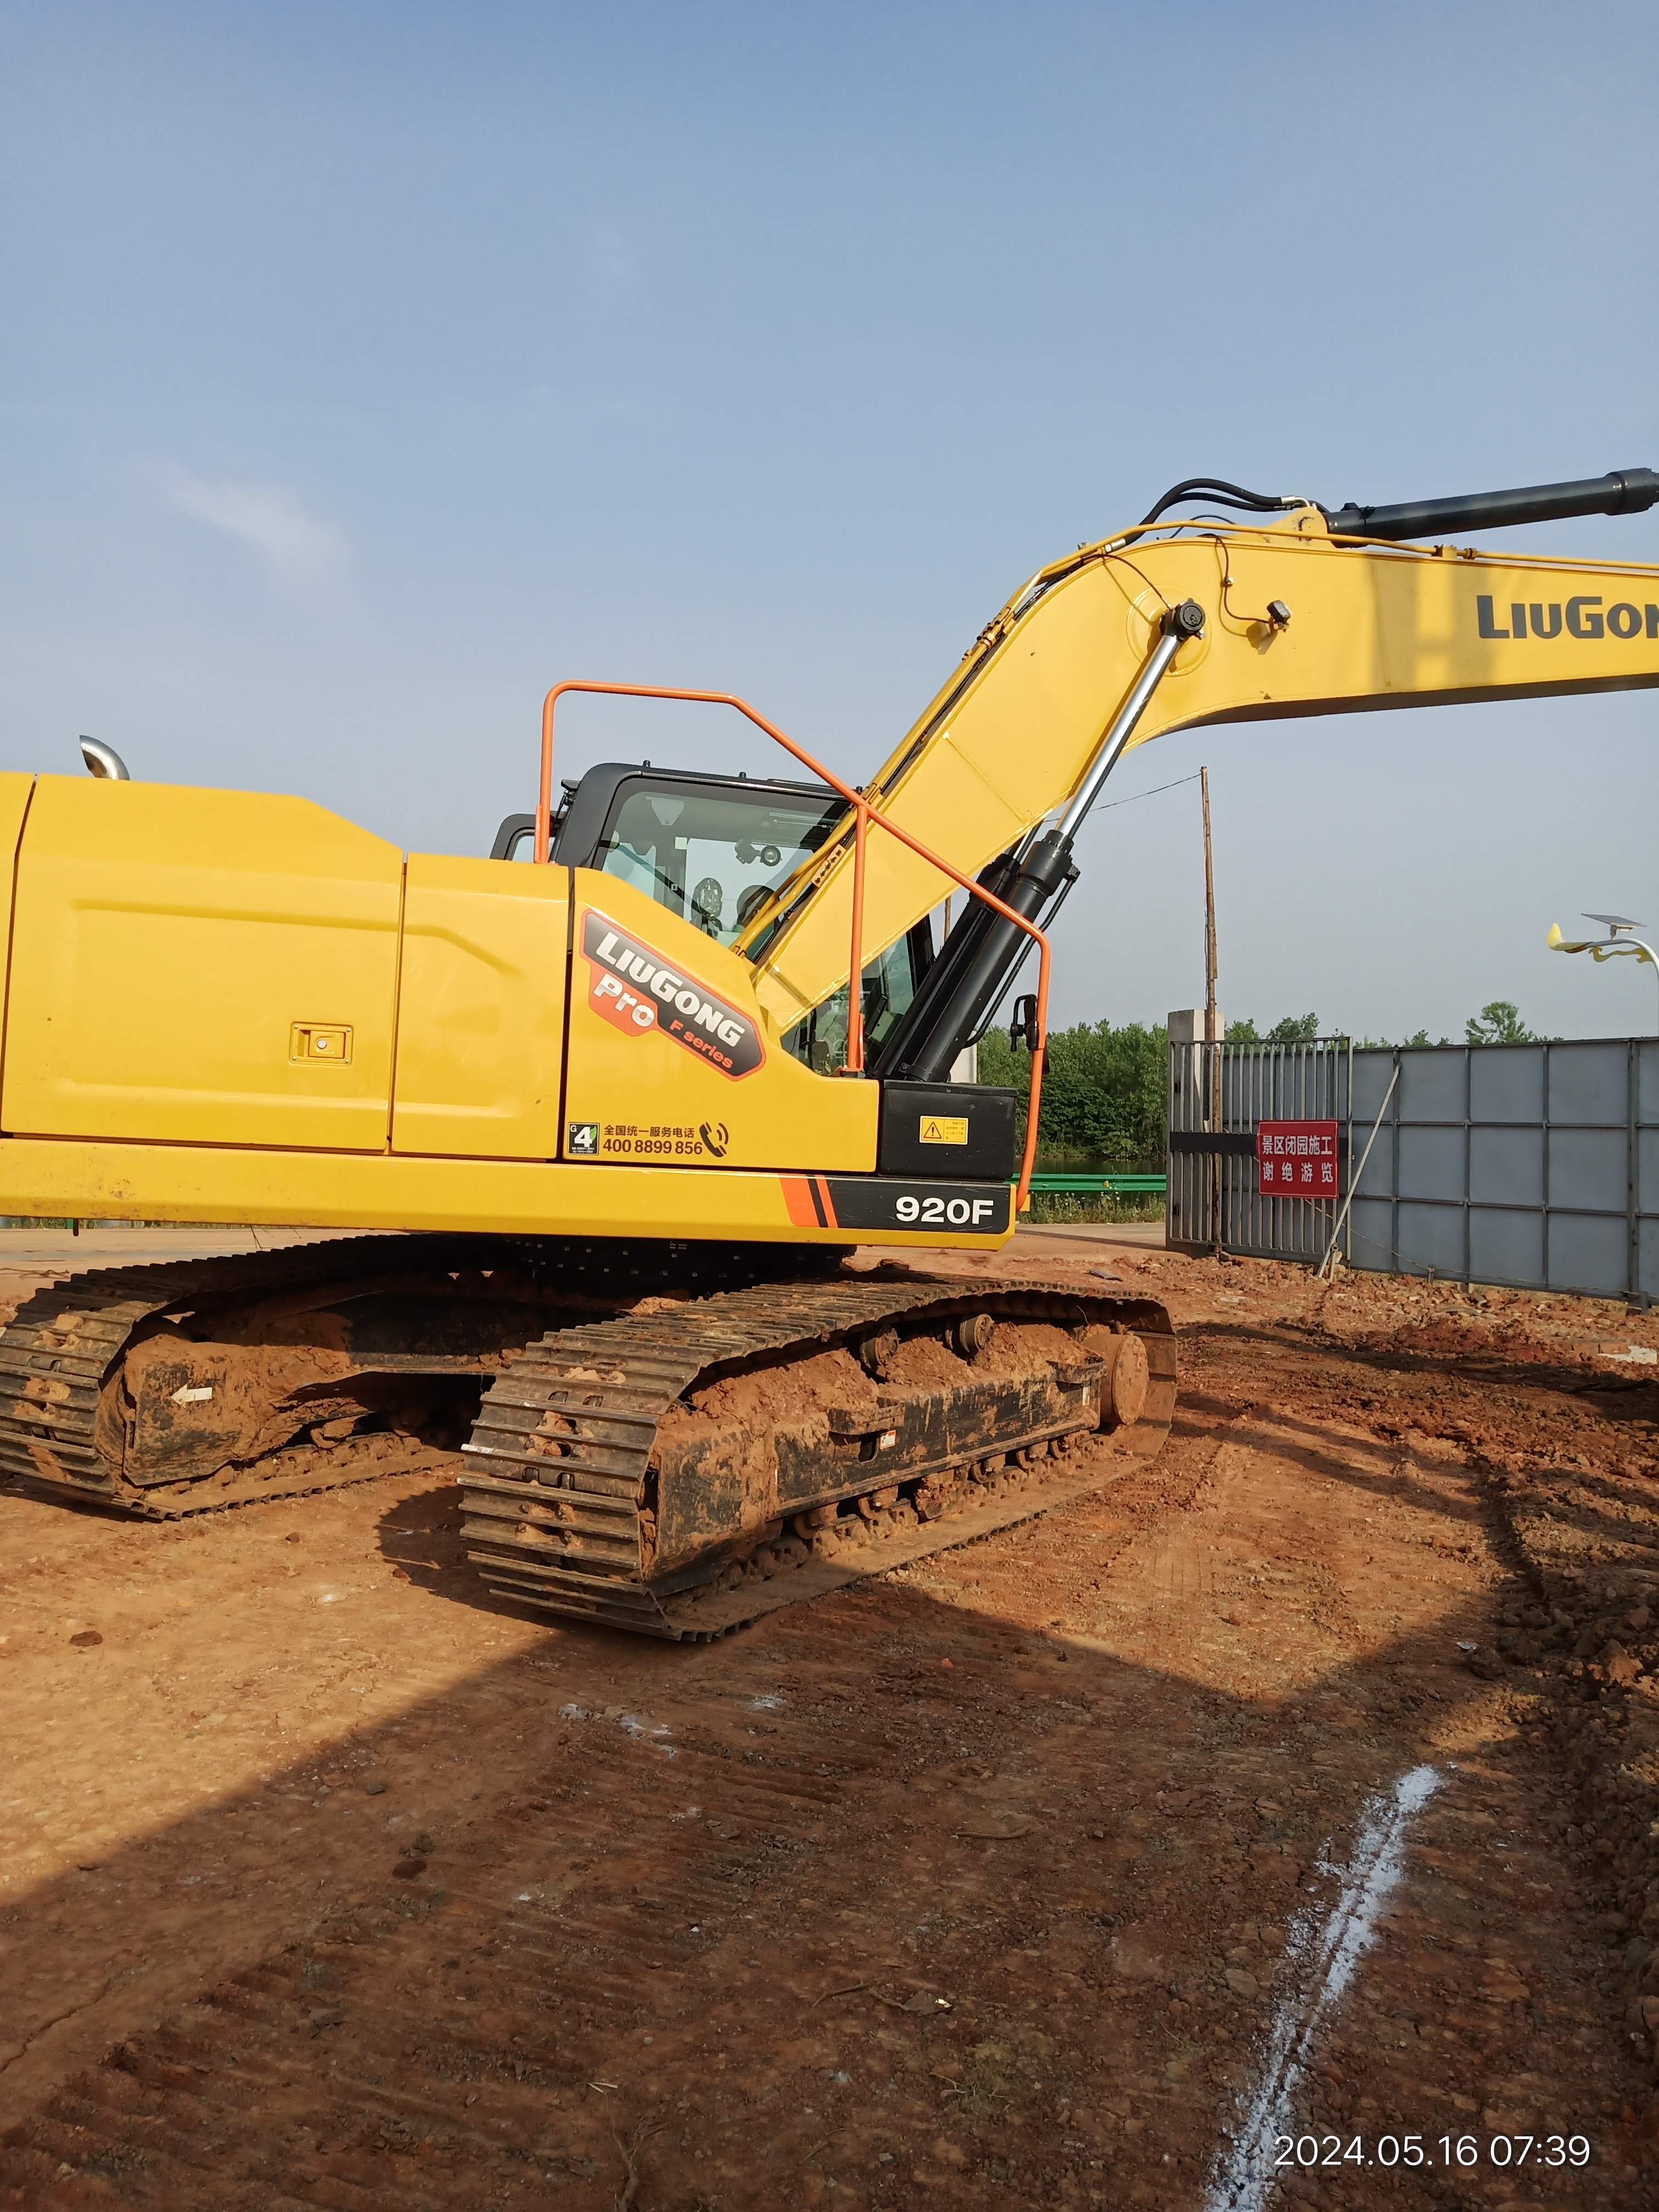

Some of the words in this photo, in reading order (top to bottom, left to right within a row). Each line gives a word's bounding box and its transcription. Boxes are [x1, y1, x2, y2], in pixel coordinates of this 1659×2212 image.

[594, 974, 654, 1027] Pro
[596, 932, 746, 1047] LIUGONG
[670, 1020, 683, 1031] F
[683, 1030, 733, 1069] series
[604, 1125, 695, 1138] 全国统一服务电话
[602, 1139, 631, 1153] 400
[634, 1139, 672, 1154] 8899
[675, 1141, 703, 1155] 856
[1263, 1136, 1332, 1155] 景区闭园施工
[1263, 1161, 1333, 1183] 谢绝游览
[896, 1196, 994, 1224] 920F
